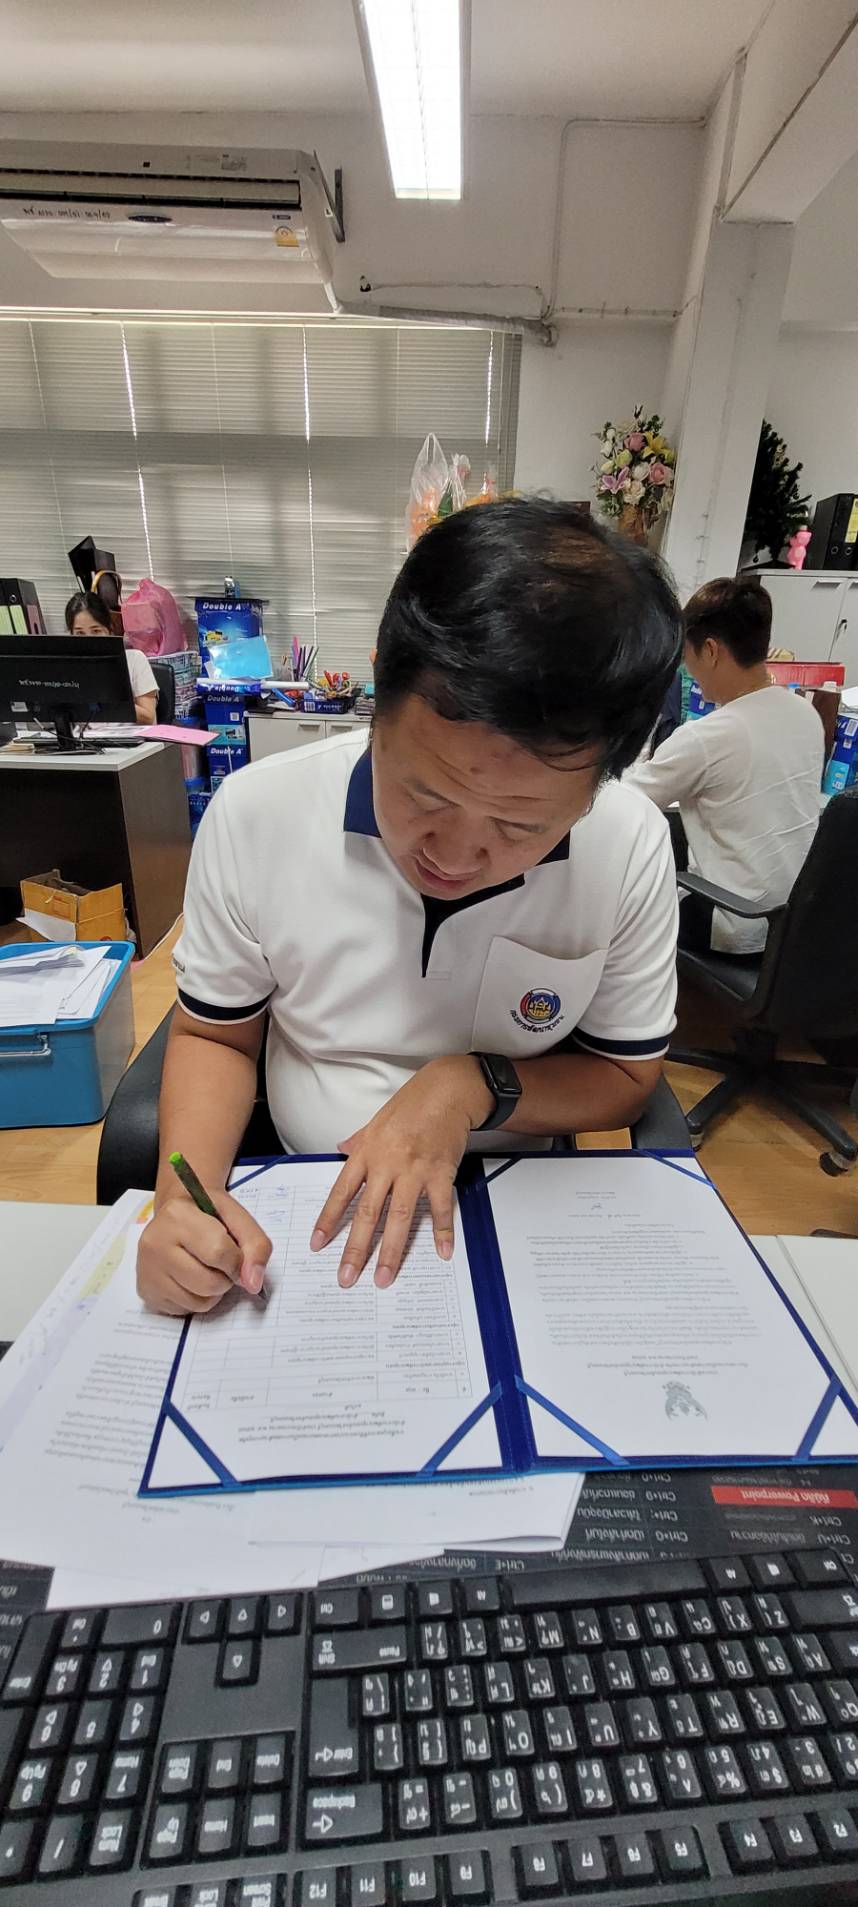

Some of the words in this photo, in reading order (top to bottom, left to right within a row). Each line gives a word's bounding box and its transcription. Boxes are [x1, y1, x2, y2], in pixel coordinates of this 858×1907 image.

[203, 602, 232, 610] Double
[741, 1490, 800, 1502] Powerpoint
[809, 1516, 842, 1526] Ctrl+K
[818, 1534, 850, 1545] Ctrl+U
[72, 1618, 87, 1630] Del
[701, 1617, 711, 1630] C
[736, 1613, 748, 1627] X
[774, 1611, 785, 1624] Z
[153, 1619, 162, 1634] 0
[589, 1626, 599, 1640] N
[627, 1623, 636, 1636] B
[665, 1622, 675, 1635] V
[548, 1630, 560, 1643] M
[140, 1654, 156, 1667] End
[775, 1656, 786, 1670] S
[812, 1653, 824, 1667] A
[659, 1666, 670, 1680] G
[701, 1663, 709, 1677] F
[736, 1660, 747, 1675] D
[9, 1676, 31, 1688] Enter
[56, 1676, 66, 1692] 3
[99, 1672, 109, 1688] 2
[142, 1670, 148, 1685] 1
[582, 1674, 589, 1690] J
[620, 1670, 632, 1686] H
[501, 1682, 509, 1696] L
[541, 1678, 551, 1692] K
[806, 1705, 820, 1720] W
[846, 1702, 858, 1714] Q
[688, 1716, 697, 1732] T
[726, 1712, 739, 1728] R
[767, 1710, 778, 1725] E
[86, 1722, 96, 1738] 5
[131, 1718, 140, 1734] 4
[604, 1725, 615, 1740] U
[648, 1720, 658, 1736] Y
[40, 1726, 51, 1742] 6
[518, 1732, 529, 1749] O
[566, 1729, 572, 1744] I
[478, 1738, 487, 1754] P
[804, 1741, 814, 1754] 3
[846, 1736, 856, 1750] 2
[721, 1749, 730, 1762] 5
[762, 1746, 770, 1759] 4
[114, 1756, 139, 1768] Home
[216, 1759, 232, 1772] End
[256, 1754, 280, 1768] Delete
[638, 1758, 646, 1773] 7
[677, 1754, 686, 1769] 6
[168, 1768, 189, 1780] Page
[549, 1766, 557, 1779] 9
[592, 1764, 601, 1778] 8
[117, 1774, 127, 1792] 7
[506, 1771, 513, 1786] 0
[22, 1784, 32, 1802] 9
[70, 1778, 80, 1797] 8
[167, 1817, 179, 1831] Up
[204, 1819, 228, 1832] Home
[833, 1823, 848, 1838] F2
[101, 1826, 122, 1839] Lock
[157, 1829, 177, 1843] Page
[744, 1832, 758, 1847] F4
[789, 1828, 803, 1843] F3
[98, 1839, 119, 1852] Num
[674, 1842, 688, 1856] F5
[582, 1852, 594, 1867] F7
[360, 1878, 375, 1892] F11
[409, 1872, 426, 1886] F10
[199, 1888, 218, 1903] Lock
[309, 1883, 326, 1899] F12
